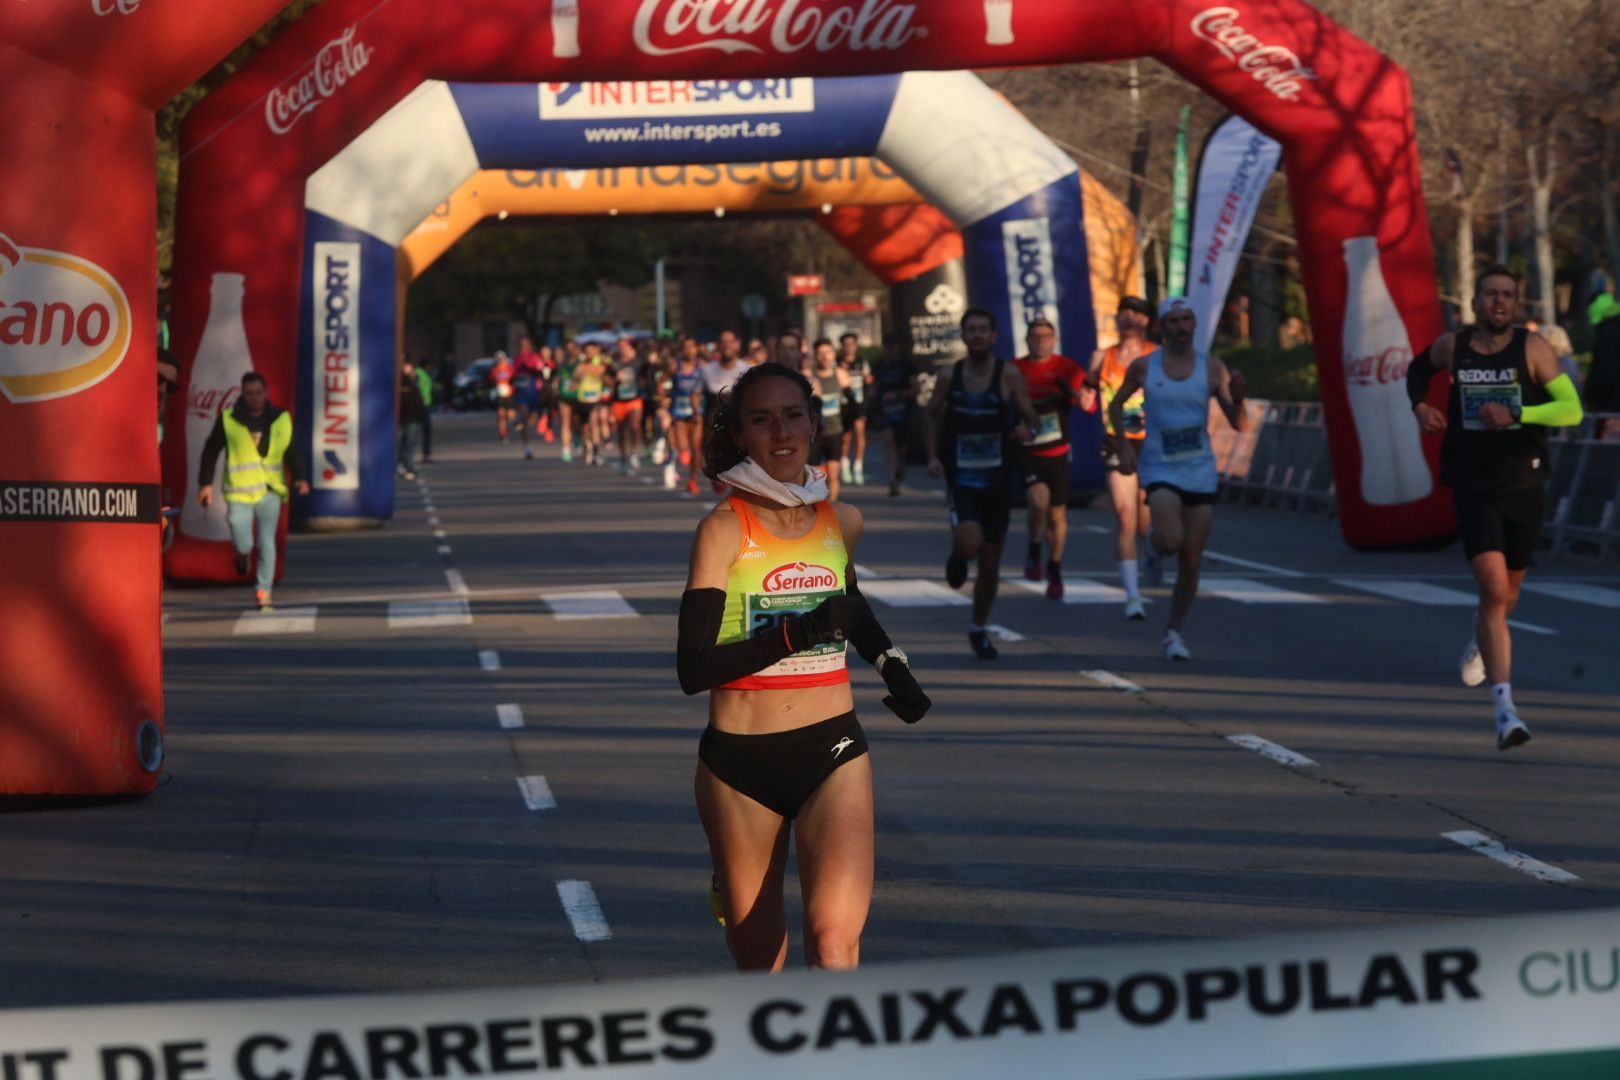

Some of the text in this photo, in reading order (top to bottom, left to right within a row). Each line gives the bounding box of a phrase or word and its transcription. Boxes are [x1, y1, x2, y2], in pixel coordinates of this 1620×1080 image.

[265, 22, 374, 135] Coca-Cola
[589, 79, 794, 106] INTERSPORT
[584, 121, 782, 142] www.intersport.es
[0, 300, 111, 347] ano
[323, 255, 349, 445] INTERSPORT
[0, 486, 137, 518] SERRANO.COM
[770, 573, 833, 591] Serrano
[101, 1042, 206, 1080] DE
[235, 1006, 716, 1080] CARRERES
